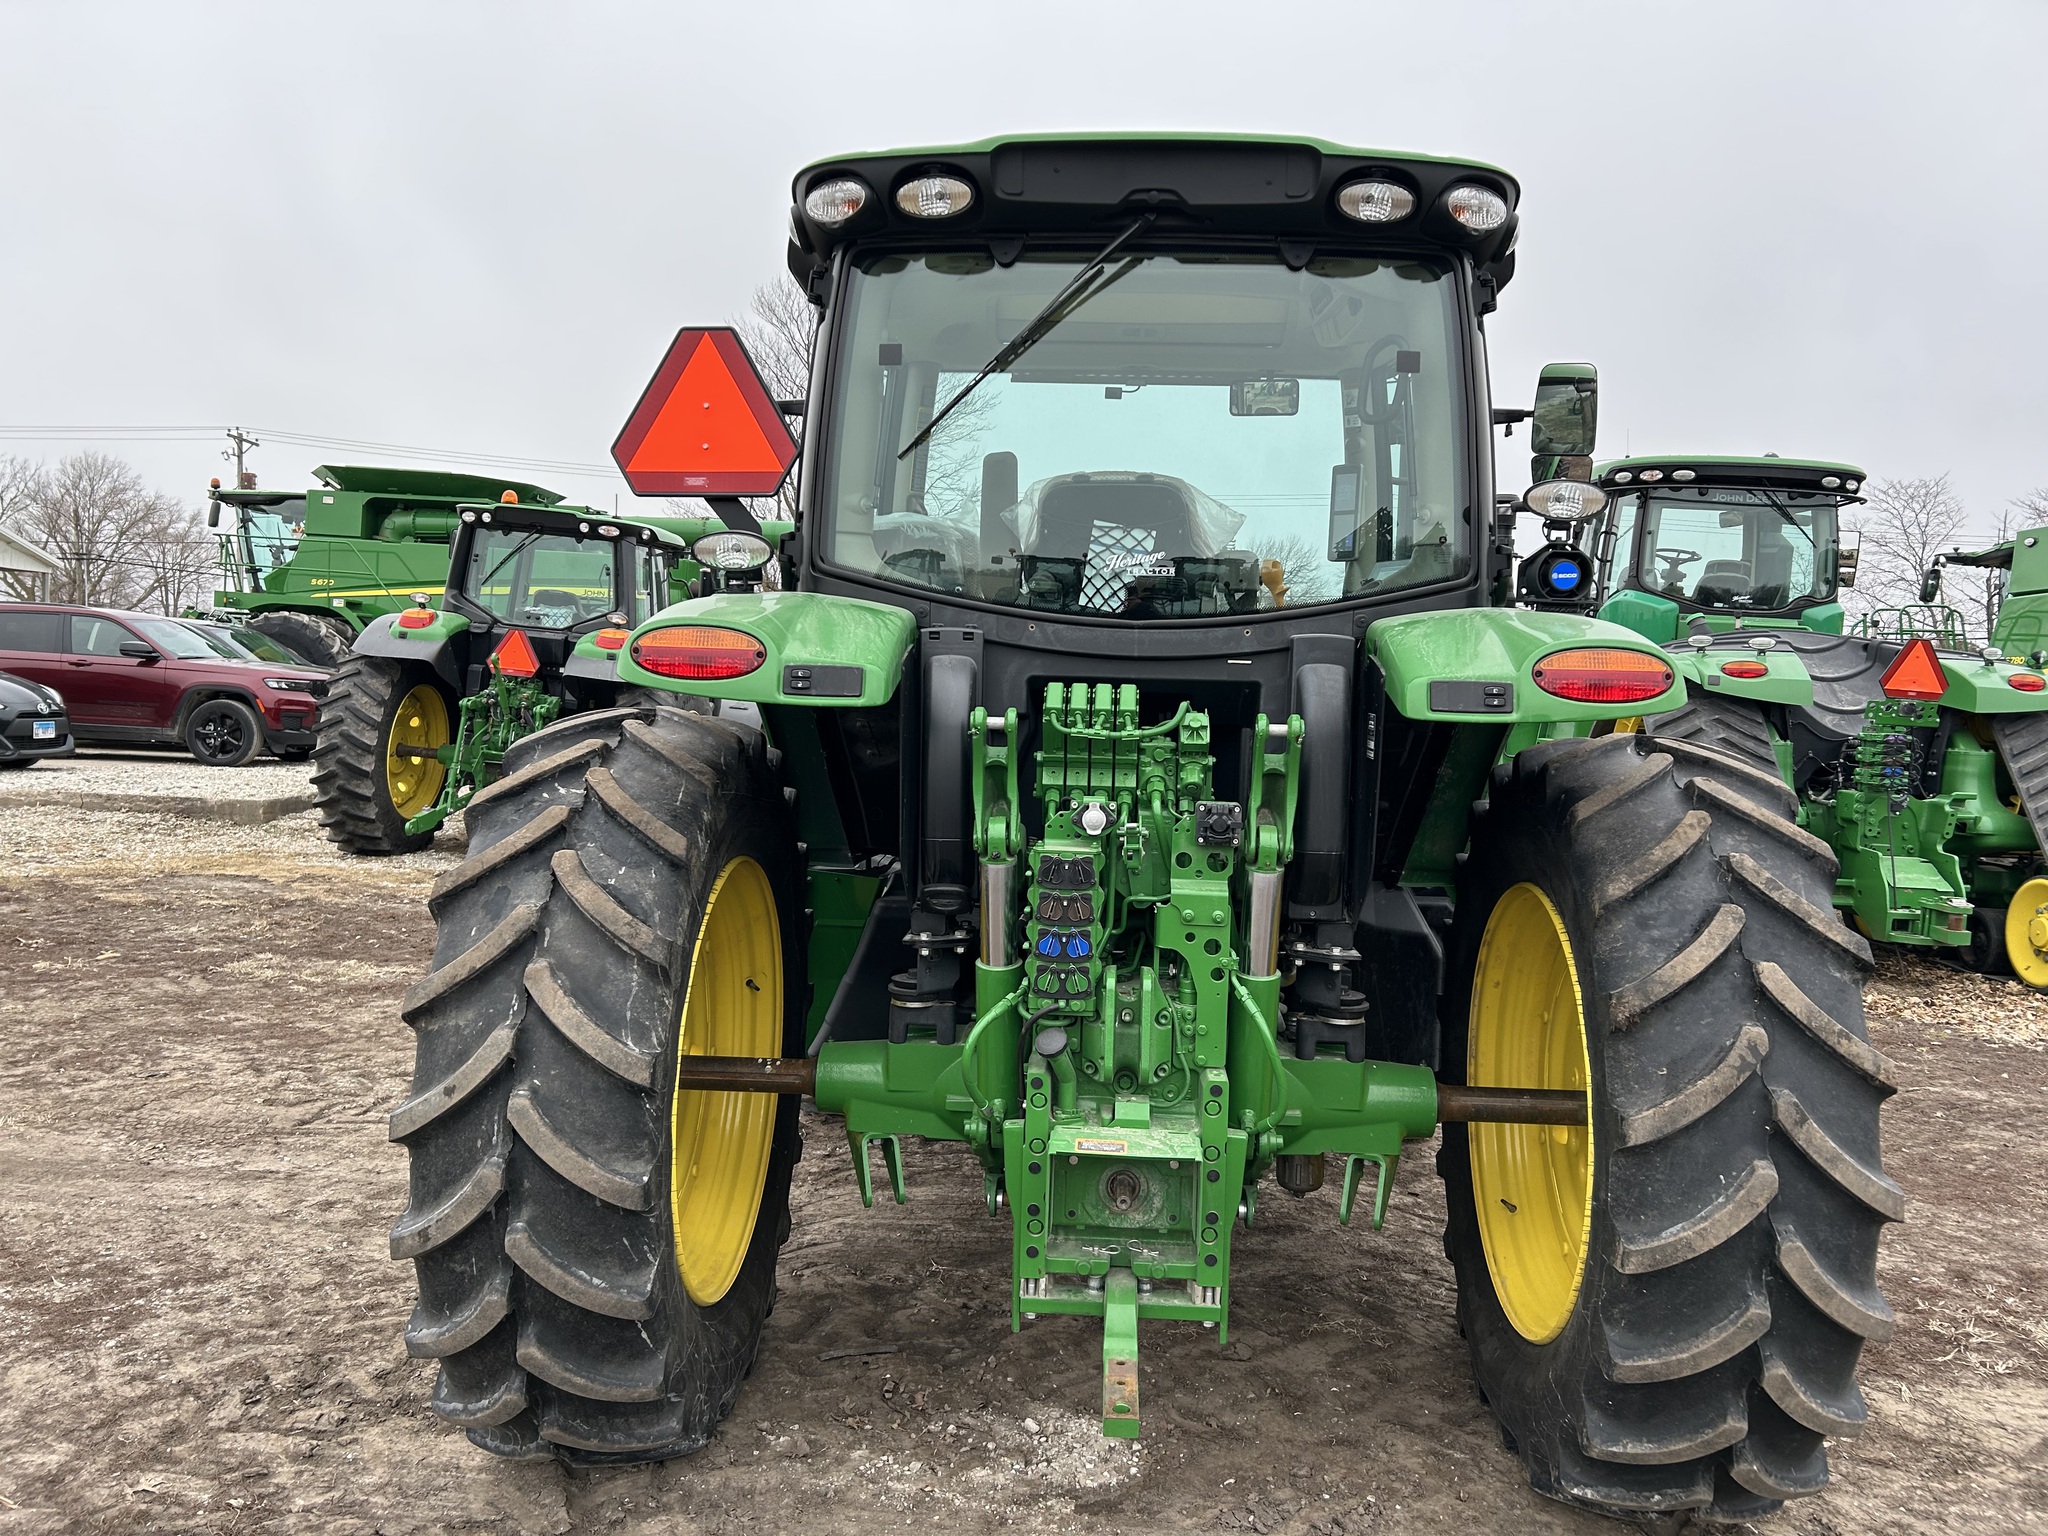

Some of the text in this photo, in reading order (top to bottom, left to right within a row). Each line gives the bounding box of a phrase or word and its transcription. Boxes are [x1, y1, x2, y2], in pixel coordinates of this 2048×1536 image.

[1713, 493, 1743, 502] JOHN
[1104, 551, 1166, 572] Heritage
[1126, 567, 1175, 576] TRACTOR
